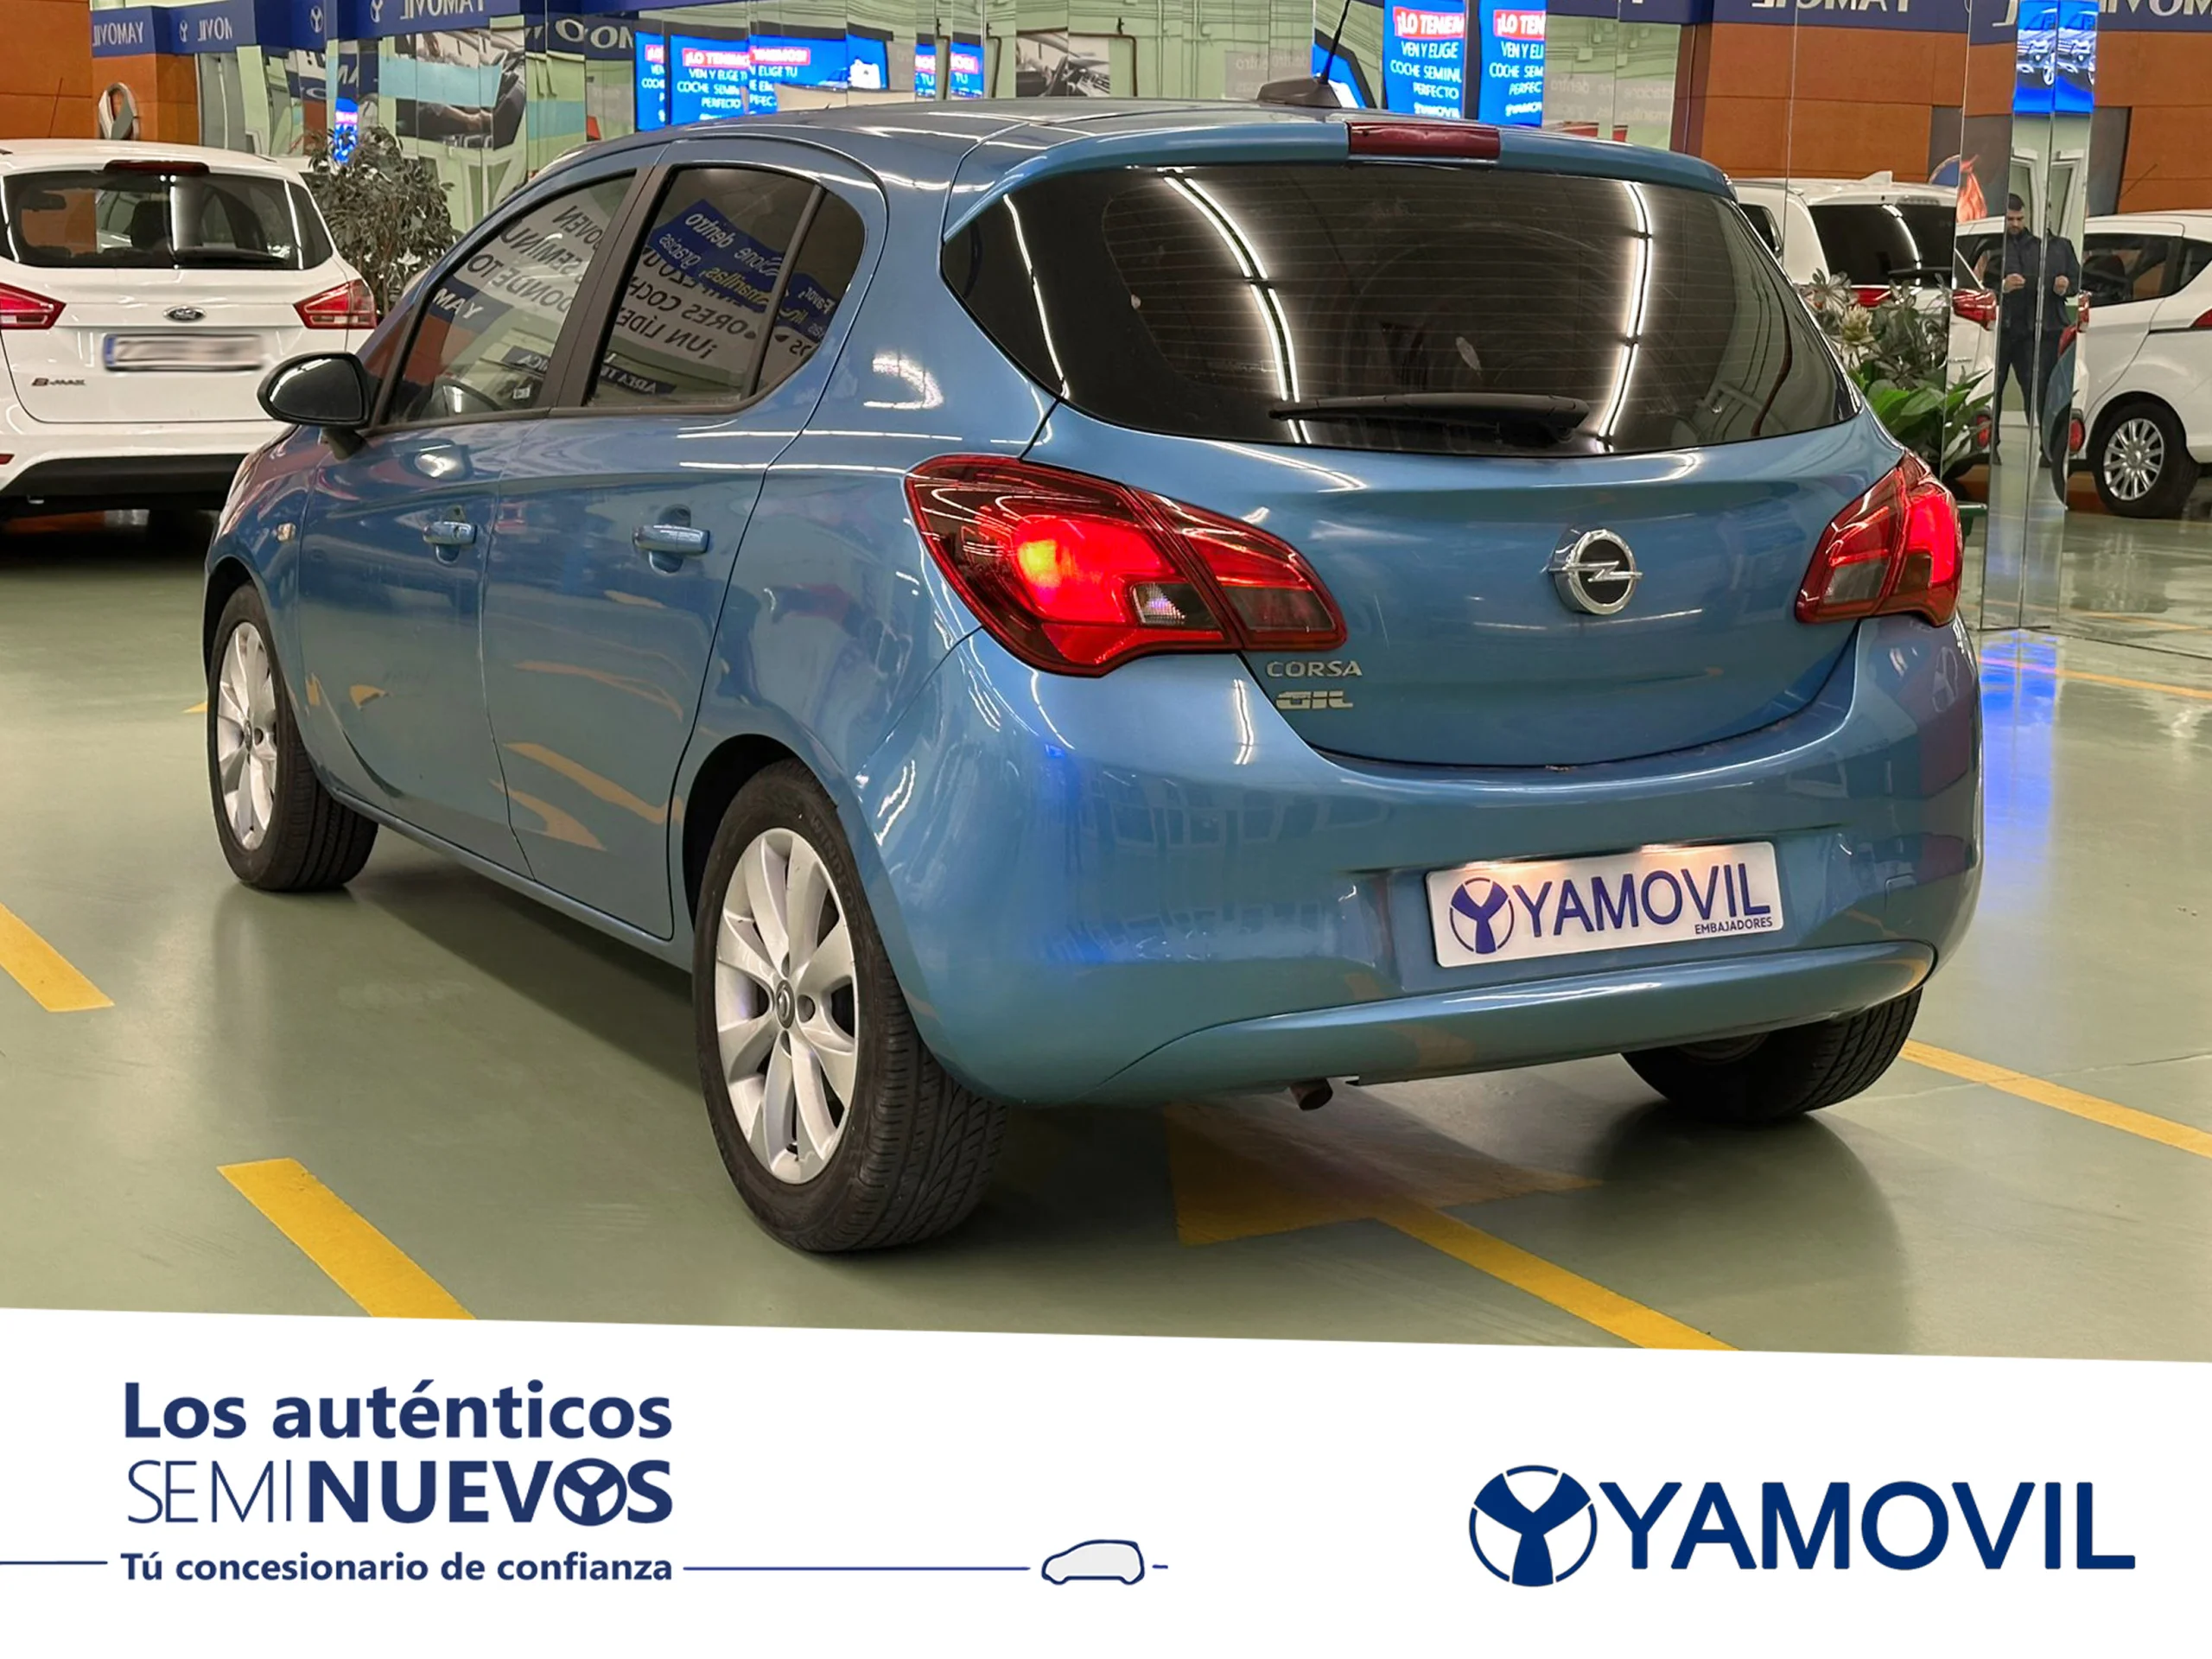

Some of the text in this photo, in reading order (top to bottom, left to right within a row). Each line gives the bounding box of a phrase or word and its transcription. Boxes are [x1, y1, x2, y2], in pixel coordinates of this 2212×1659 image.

[1266, 660, 1363, 677] CORSA
[1513, 863, 1771, 938] YAMOVIL
[1694, 917, 1773, 936] EMBAJADORES
